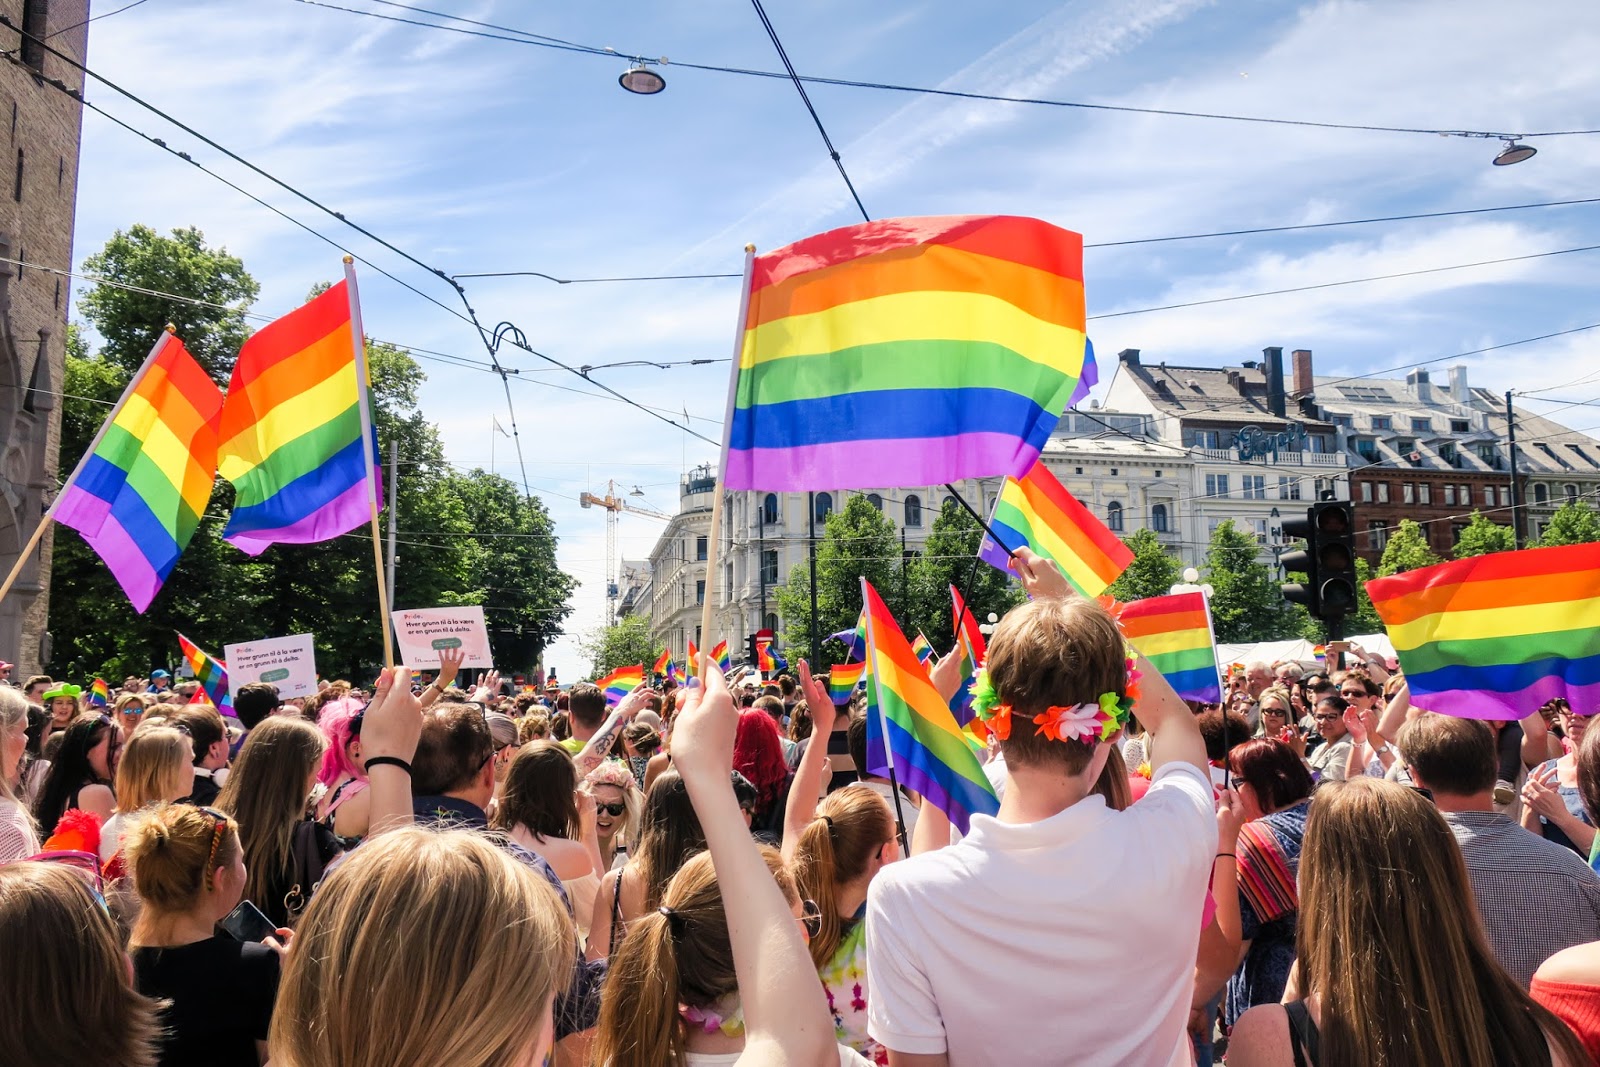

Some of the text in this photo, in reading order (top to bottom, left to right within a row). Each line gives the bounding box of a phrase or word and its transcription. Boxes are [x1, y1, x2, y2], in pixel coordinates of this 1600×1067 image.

[422, 620, 440, 628] grunn
[424, 627, 442, 635] grunn
[252, 653, 269, 662] grunn
[254, 660, 270, 668] grunn
